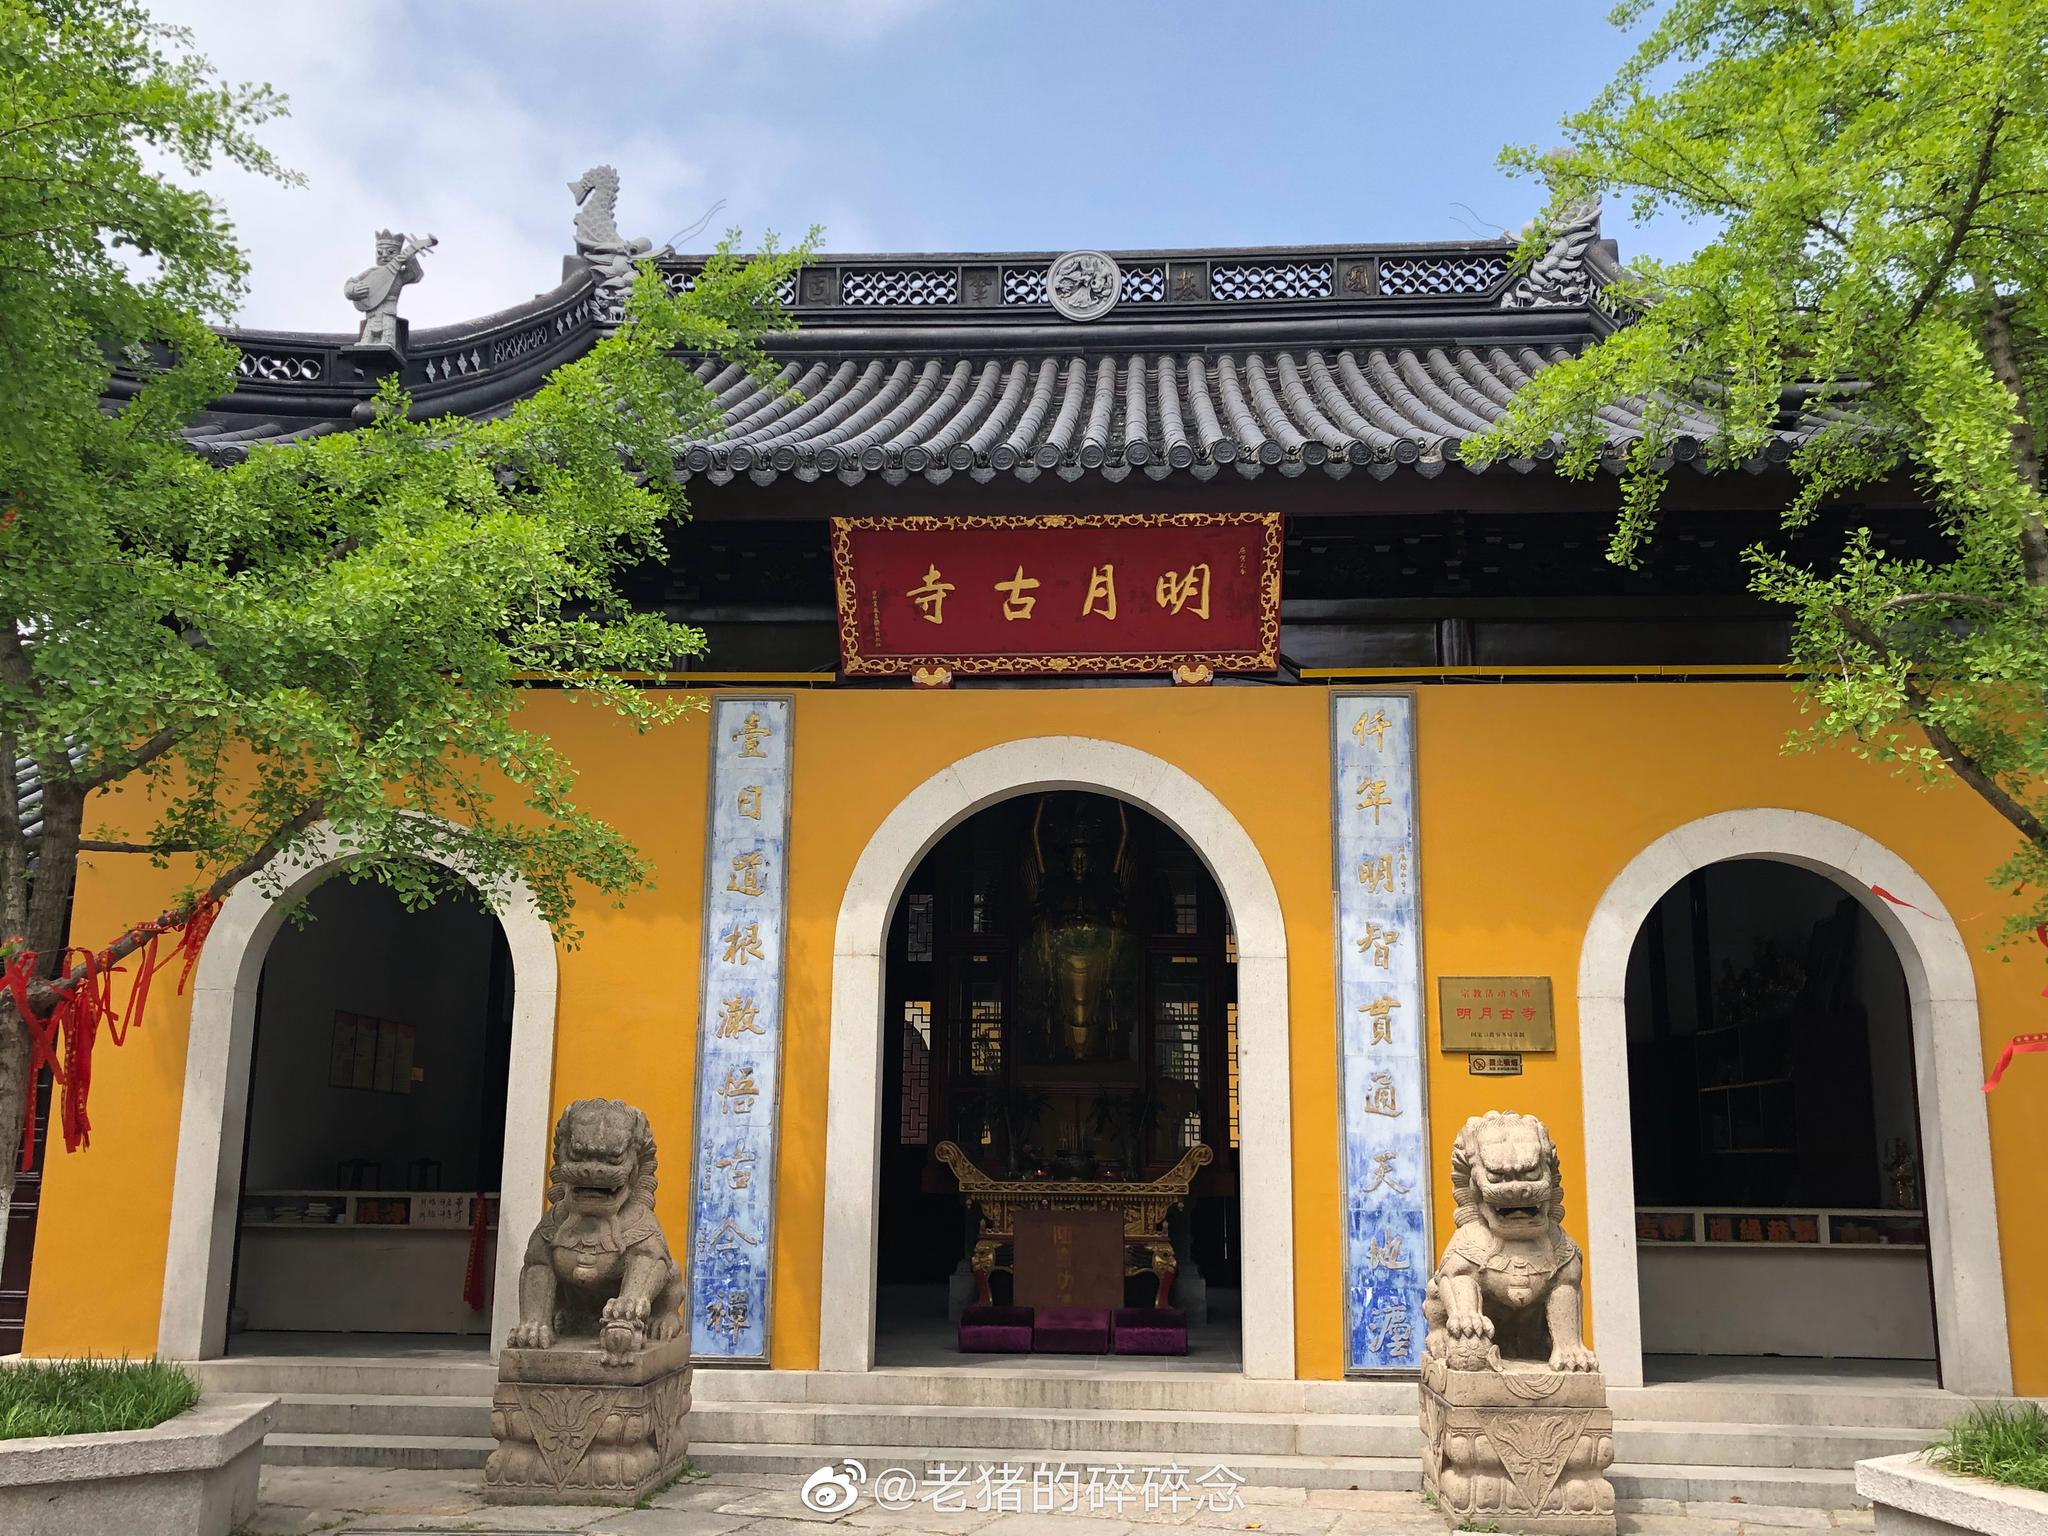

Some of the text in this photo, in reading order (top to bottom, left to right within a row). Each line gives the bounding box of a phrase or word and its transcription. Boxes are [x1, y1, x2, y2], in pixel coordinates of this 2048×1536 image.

[906, 563, 1211, 625] 明月古寺
[1456, 1007, 1537, 1020] 明月古寺
